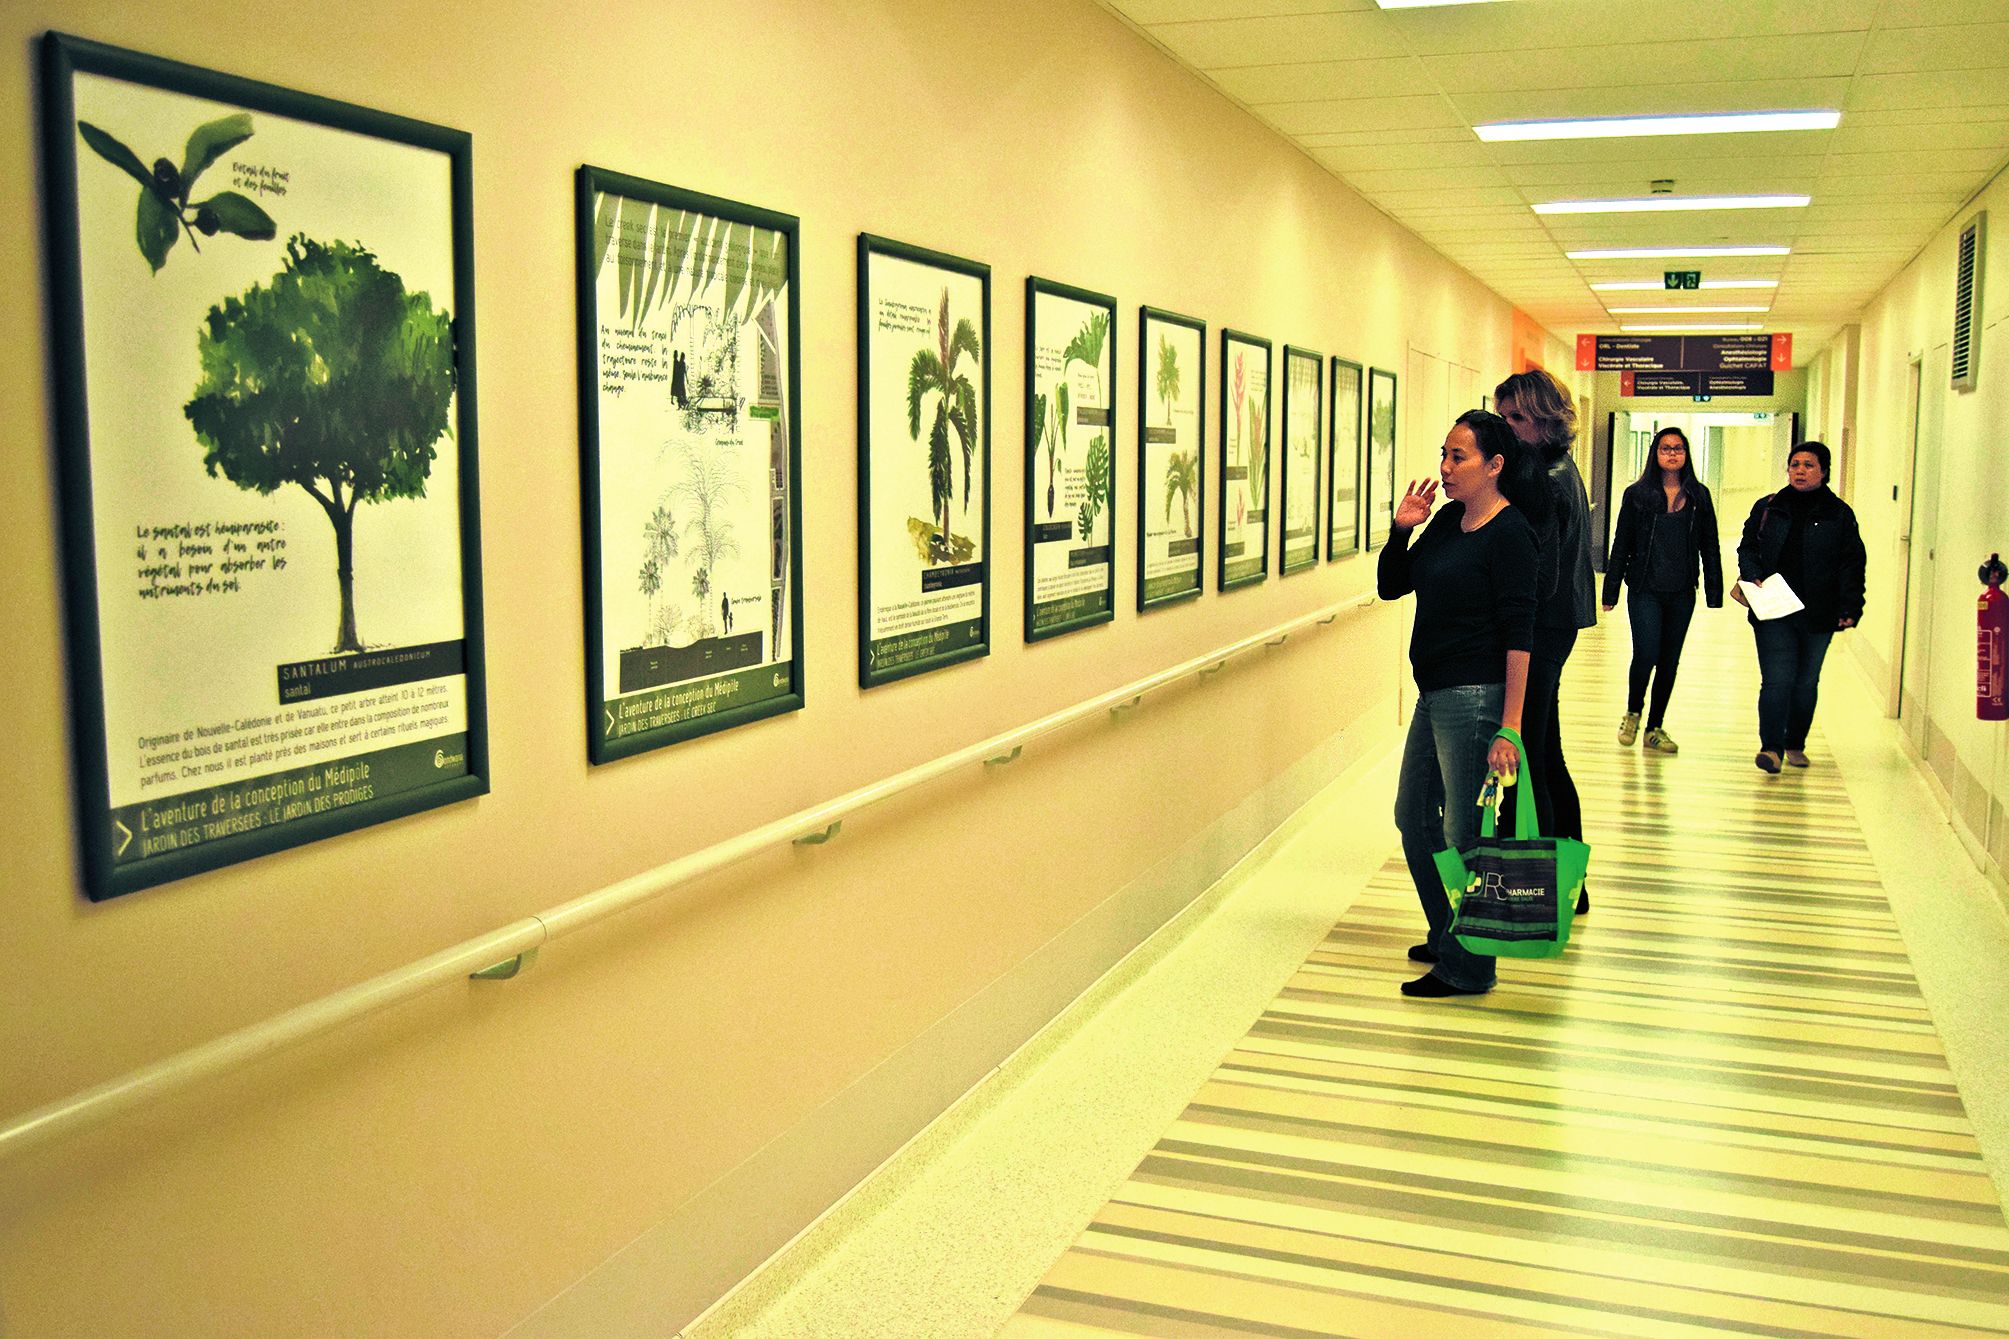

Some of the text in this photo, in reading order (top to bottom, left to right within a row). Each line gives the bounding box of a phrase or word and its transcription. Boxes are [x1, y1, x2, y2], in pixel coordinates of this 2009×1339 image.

[244, 178, 258, 191] des
[642, 358, 656, 368] reste
[137, 525, 149, 538] Le
[153, 522, 192, 540] santal
[194, 522, 211, 538] est
[137, 537, 286, 560] il a besoin d'un autre
[138, 554, 287, 586] végétal pour absorber les
[138, 581, 204, 599] nutriments
[206, 577, 220, 593] du
[283, 651, 431, 680] SANTALUM AUSTROCALEDONICUM
[284, 683, 311, 698] santal
[618, 700, 652, 719] L'aventure
[654, 696, 662, 710] de
[664, 695, 671, 708] la
[672, 688, 704, 706] conception
[705, 686, 713, 698] du
[138, 732, 180, 751] Originaire
[184, 730, 194, 741] de
[197, 715, 272, 738] Nouvelle-Calédonie
[274, 714, 283, 724] et
[286, 712, 295, 722] de
[330, 705, 339, 714] ce
[340, 700, 356, 716] petit
[359, 696, 376, 709] arbre
[378, 692, 399, 706] atteint
[411, 689, 416, 698] à
[417, 687, 424, 698] 12
[140, 700, 449, 768] L'essence du bois de santal est très prisée car elle entre dans la composition de nombreux
[618, 721, 637, 738] JARDIN
[638, 718, 648, 732] DES
[684, 707, 690, 719] LE
[707, 702, 716, 714] SEC
[140, 770, 177, 787] parfums.
[182, 764, 202, 778] Chez
[204, 761, 224, 772] nous
[226, 759, 232, 768] il
[234, 756, 247, 768] est
[250, 750, 273, 768] planté
[275, 748, 292, 761] près
[294, 742, 306, 754] des
[309, 736, 337, 750] maisons
[340, 736, 347, 745] et
[348, 730, 362, 742] sert
[364, 730, 369, 740] à
[370, 726, 396, 739] certains
[398, 720, 418, 734] rituels
[141, 803, 207, 832] L'aventure
[212, 796, 226, 814] de
[230, 794, 241, 811] la
[245, 778, 305, 807] conception
[308, 773, 322, 791] du
[142, 830, 178, 858] JARDIN
[180, 826, 200, 847] DES
[270, 808, 280, 824] LE
[283, 800, 312, 822] JARDIN
[314, 794, 331, 814] DES
[334, 784, 374, 806] PRODIGES
